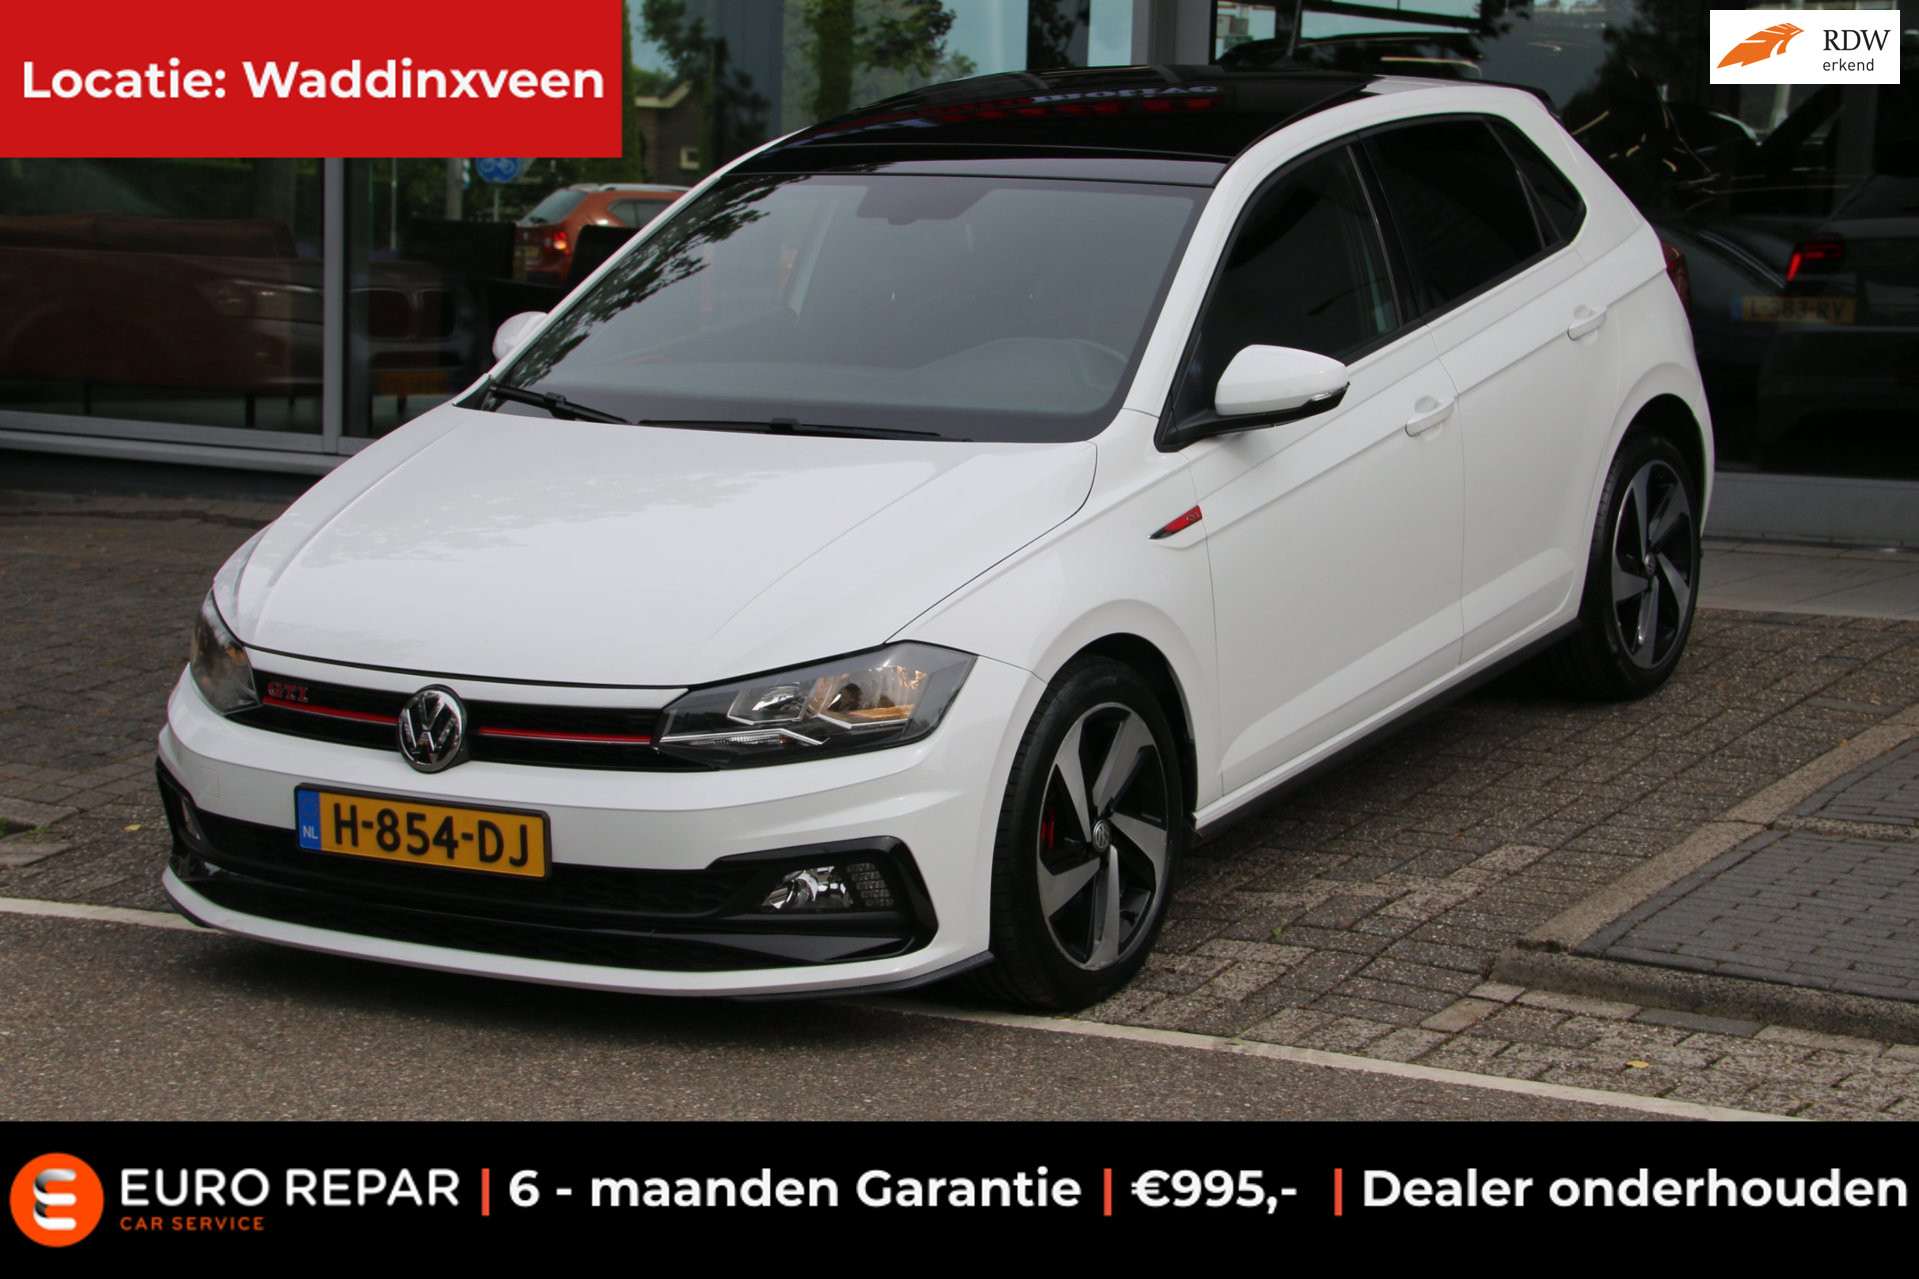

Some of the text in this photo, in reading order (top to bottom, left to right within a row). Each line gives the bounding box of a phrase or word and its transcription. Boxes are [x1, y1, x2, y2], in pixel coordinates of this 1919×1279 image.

[267, 680, 308, 703] GTI
[303, 825, 318, 840] NL
[333, 802, 529, 867] H-854-DJ
